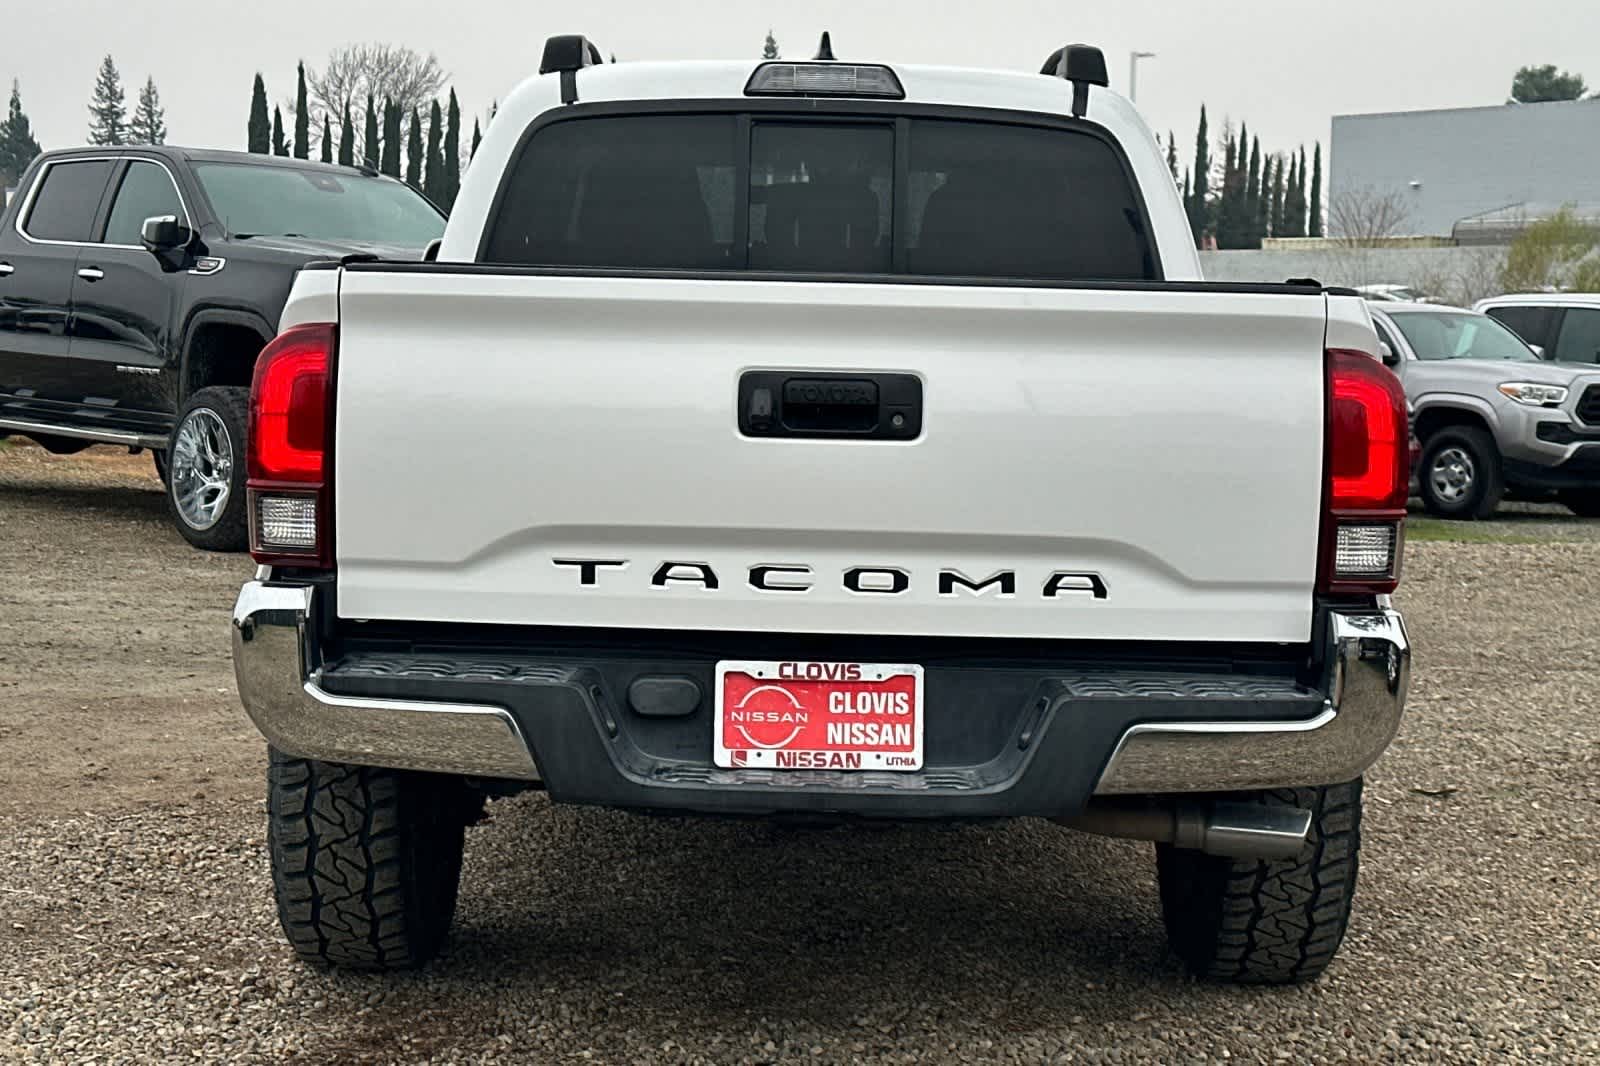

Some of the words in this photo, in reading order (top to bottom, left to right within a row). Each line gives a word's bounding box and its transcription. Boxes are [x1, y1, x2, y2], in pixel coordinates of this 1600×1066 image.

[552, 558, 1111, 599] TACOMA
[779, 662, 862, 681] CLOVIS
[829, 692, 909, 714] CLOVIS
[731, 711, 808, 723] NISSAN
[827, 723, 911, 745] NISSAN
[775, 751, 861, 769] NISSAN
[886, 757, 916, 766] LITHIA
